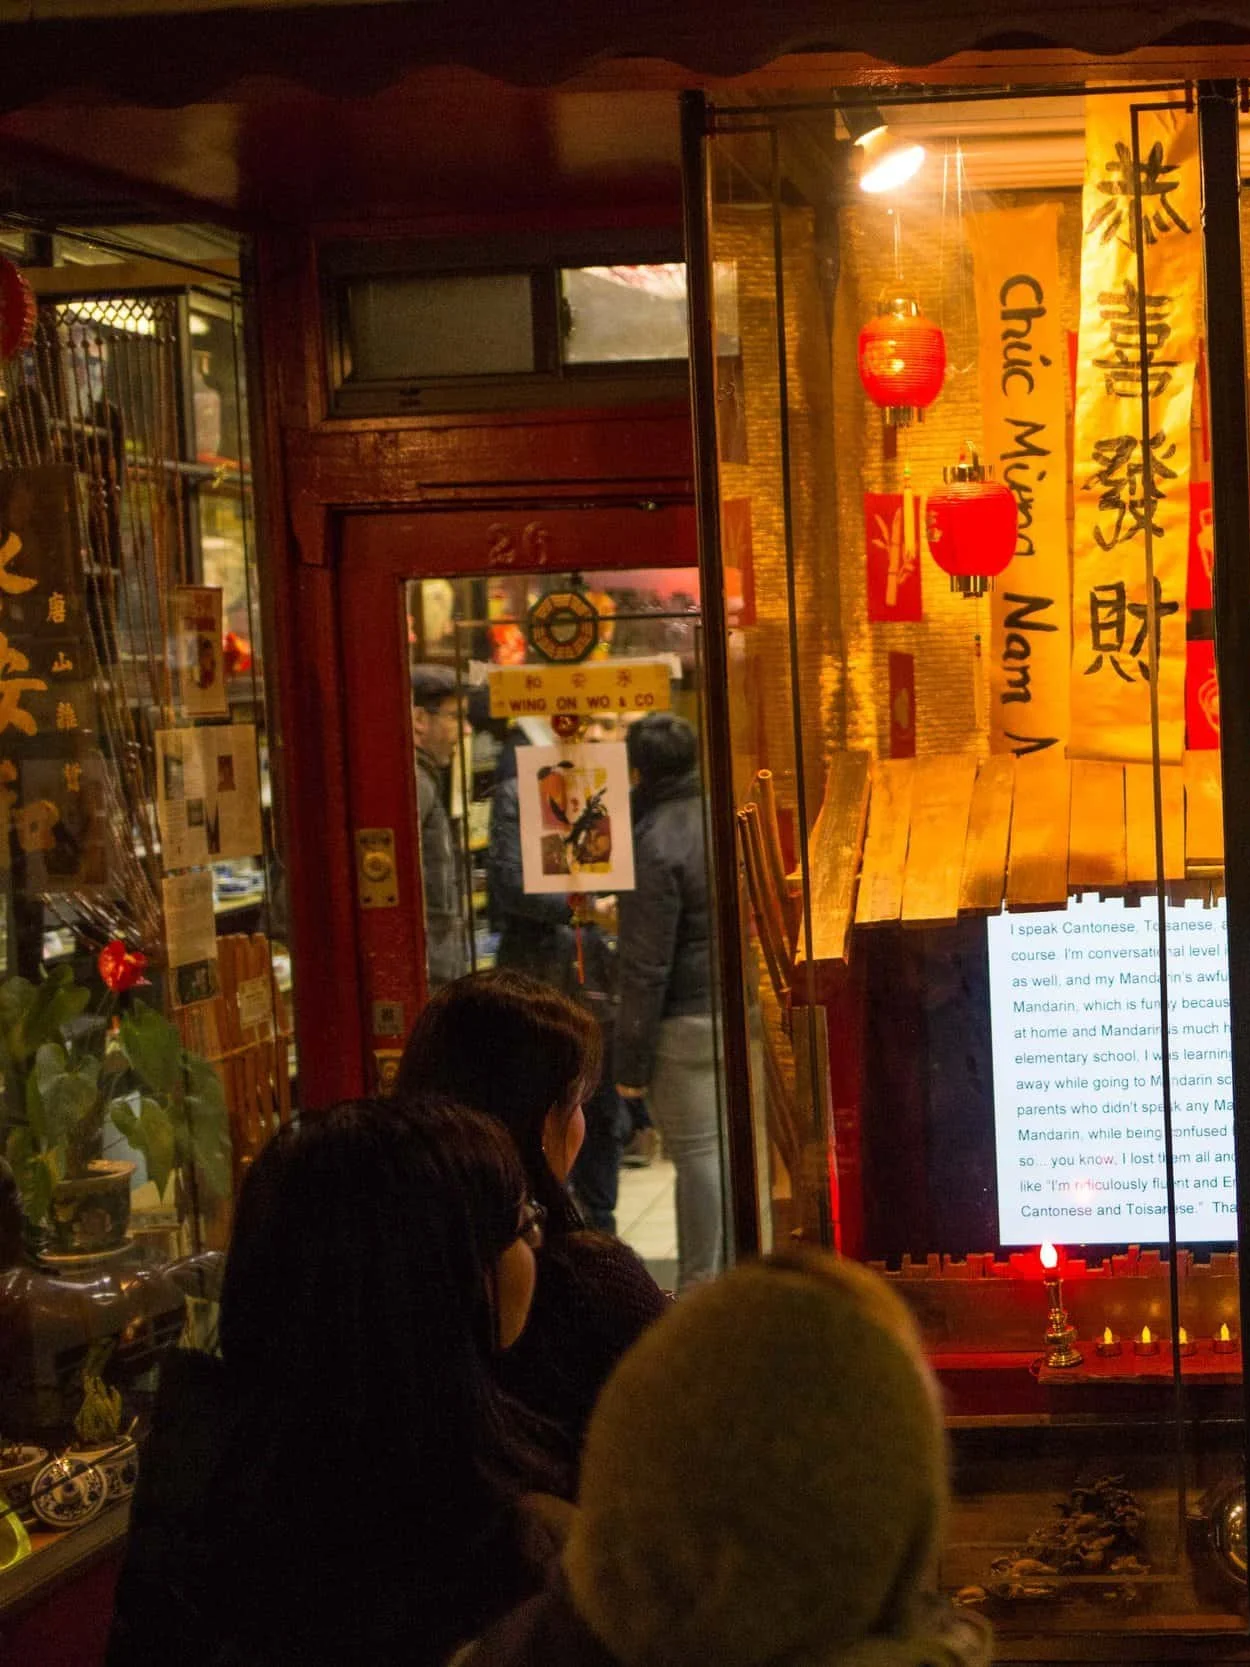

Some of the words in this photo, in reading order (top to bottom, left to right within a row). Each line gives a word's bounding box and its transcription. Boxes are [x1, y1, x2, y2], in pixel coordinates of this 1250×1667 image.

[1000, 273, 1051, 397] Chúc
[1085, 140, 1192, 683] 恭喜發財
[487, 520, 548, 566] 26
[1001, 592, 1059, 704] Nam
[509, 697, 547, 712] WING
[556, 696, 577, 710] ON
[586, 695, 610, 709] WO
[634, 693, 655, 706] CO
[1018, 922, 1058, 939] speak
[1144, 918, 1217, 934] Tosanese,
[1064, 947, 1084, 960] I'm
[1087, 944, 1185, 960] conversatial
[1188, 943, 1221, 957] level
[1012, 977, 1029, 988] as
[1065, 972, 1091, 986] and
[1095, 975, 1115, 988] my
[1196, 969, 1229, 983] awfu
[1083, 998, 1122, 1012] which
[1125, 997, 1137, 1011] is
[1141, 996, 1177, 1013] funy
[1181, 995, 1231, 1009] becaus
[1014, 1026, 1028, 1039] at
[1030, 1025, 1068, 1039] home
[1072, 1024, 1097, 1038] and
[1182, 1021, 1220, 1035] much
[1014, 1050, 1088, 1068] elementary
[1092, 1049, 1140, 1064] school,
[1151, 1050, 1179, 1061] ws
[1016, 1079, 1050, 1093] away
[1054, 1075, 1089, 1089] while
[1092, 1074, 1129, 1091] going
[1133, 1074, 1146, 1087] to
[1149, 1072, 1213, 1087] Mndarin
[1016, 1102, 1067, 1119] parents
[1070, 1101, 1098, 1115] who
[1102, 1100, 1138, 1114] didn't
[1141, 1099, 1182, 1116] spek
[1185, 1101, 1209, 1115] any
[1087, 1126, 1122, 1140] while
[1126, 1125, 1162, 1142] being
[1172, 1124, 1228, 1138] onfused
[1050, 1156, 1075, 1169] you
[1130, 1151, 1155, 1164] lost
[1195, 1150, 1210, 1163] all
[1019, 1179, 1043, 1193] like
[1151, 1176, 1190, 1190] flunt
[1193, 1175, 1218, 1189] and
[1021, 1203, 1093, 1218] Cantonese
[1096, 1203, 1122, 1216] and
[1211, 1200, 1238, 1214] Tha
